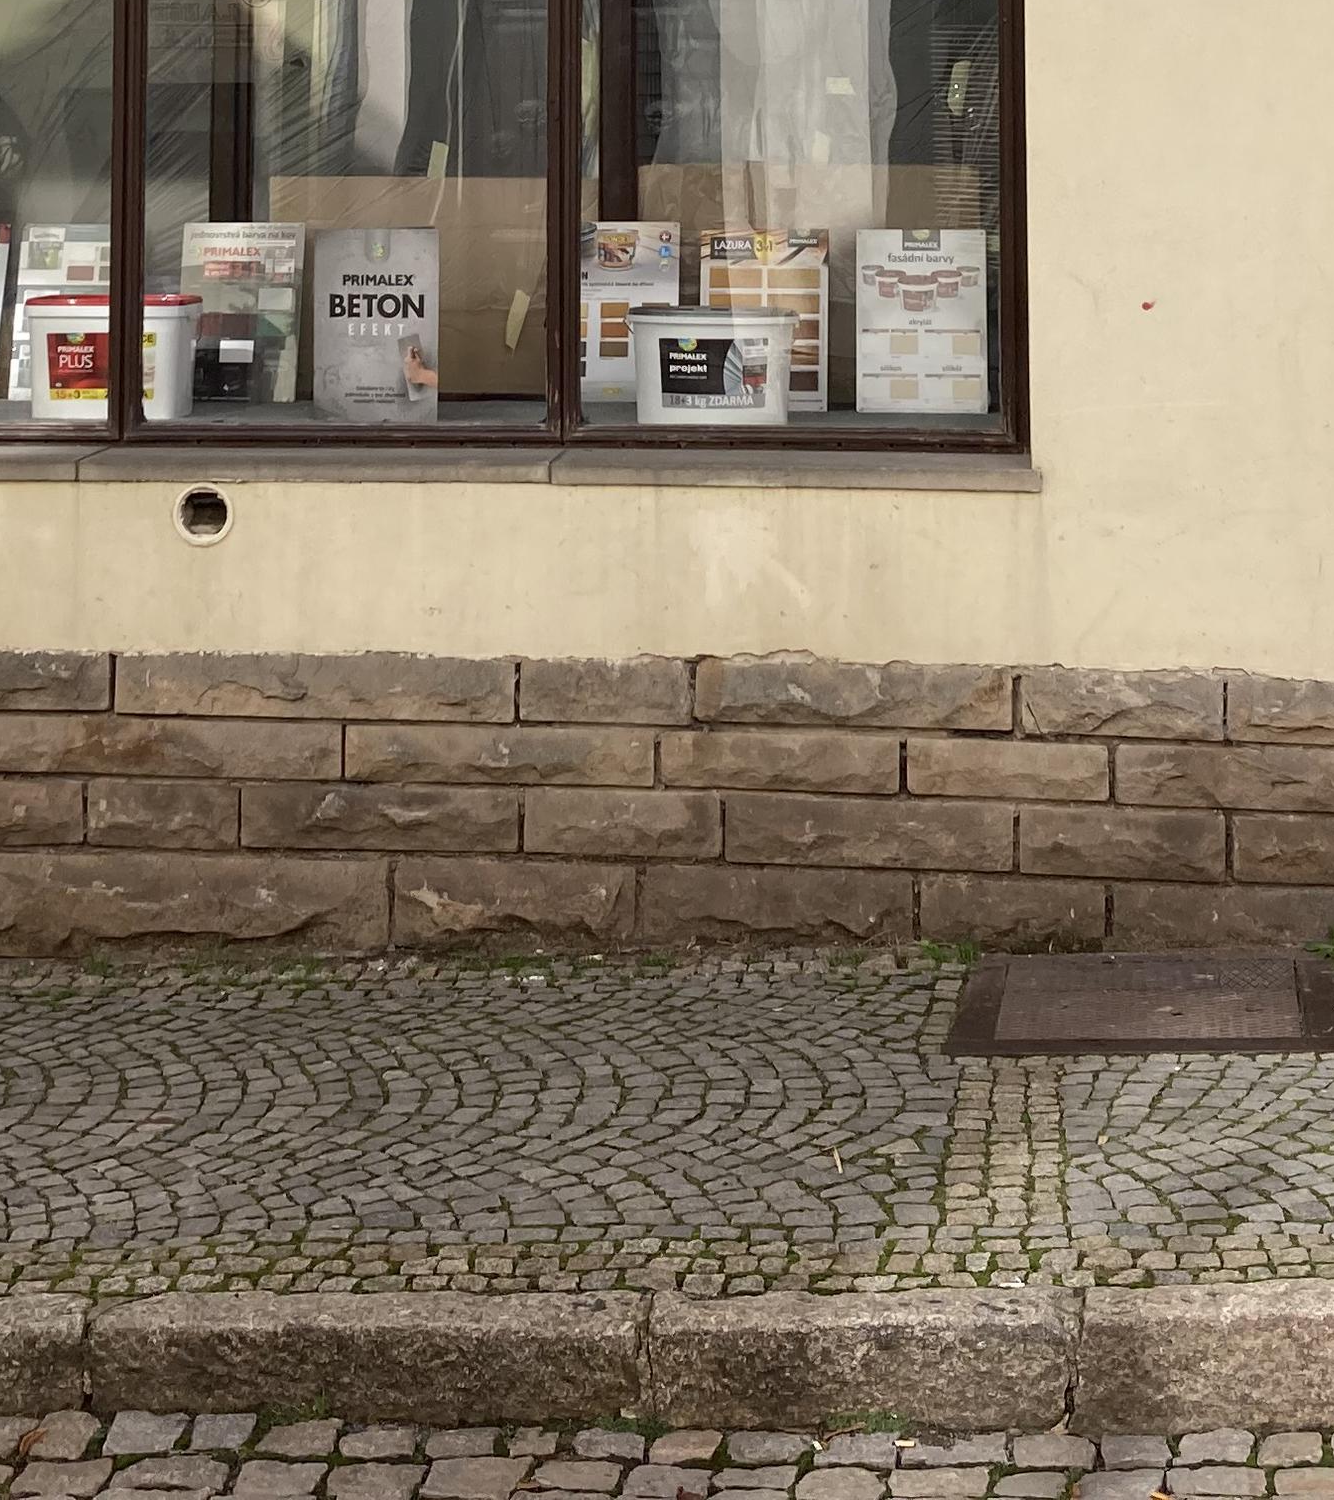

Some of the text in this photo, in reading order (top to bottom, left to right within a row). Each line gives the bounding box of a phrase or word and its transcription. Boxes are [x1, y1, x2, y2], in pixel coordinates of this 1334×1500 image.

[714, 240, 752, 250] LAZURA
[203, 247, 261, 257] PRIMALEX
[887, 253, 955, 265] fasádní barvy
[342, 274, 414, 287] PRIMALEX
[329, 293, 425, 319] BETON
[348, 323, 406, 337] EFEKT
[57, 346, 95, 354] PRIMALEX
[59, 354, 94, 369] PLUS
[669, 352, 707, 361] PRIMALEX
[669, 364, 708, 374] projekt
[694, 395, 707, 409] kg
[708, 395, 754, 406] ZDARMA
